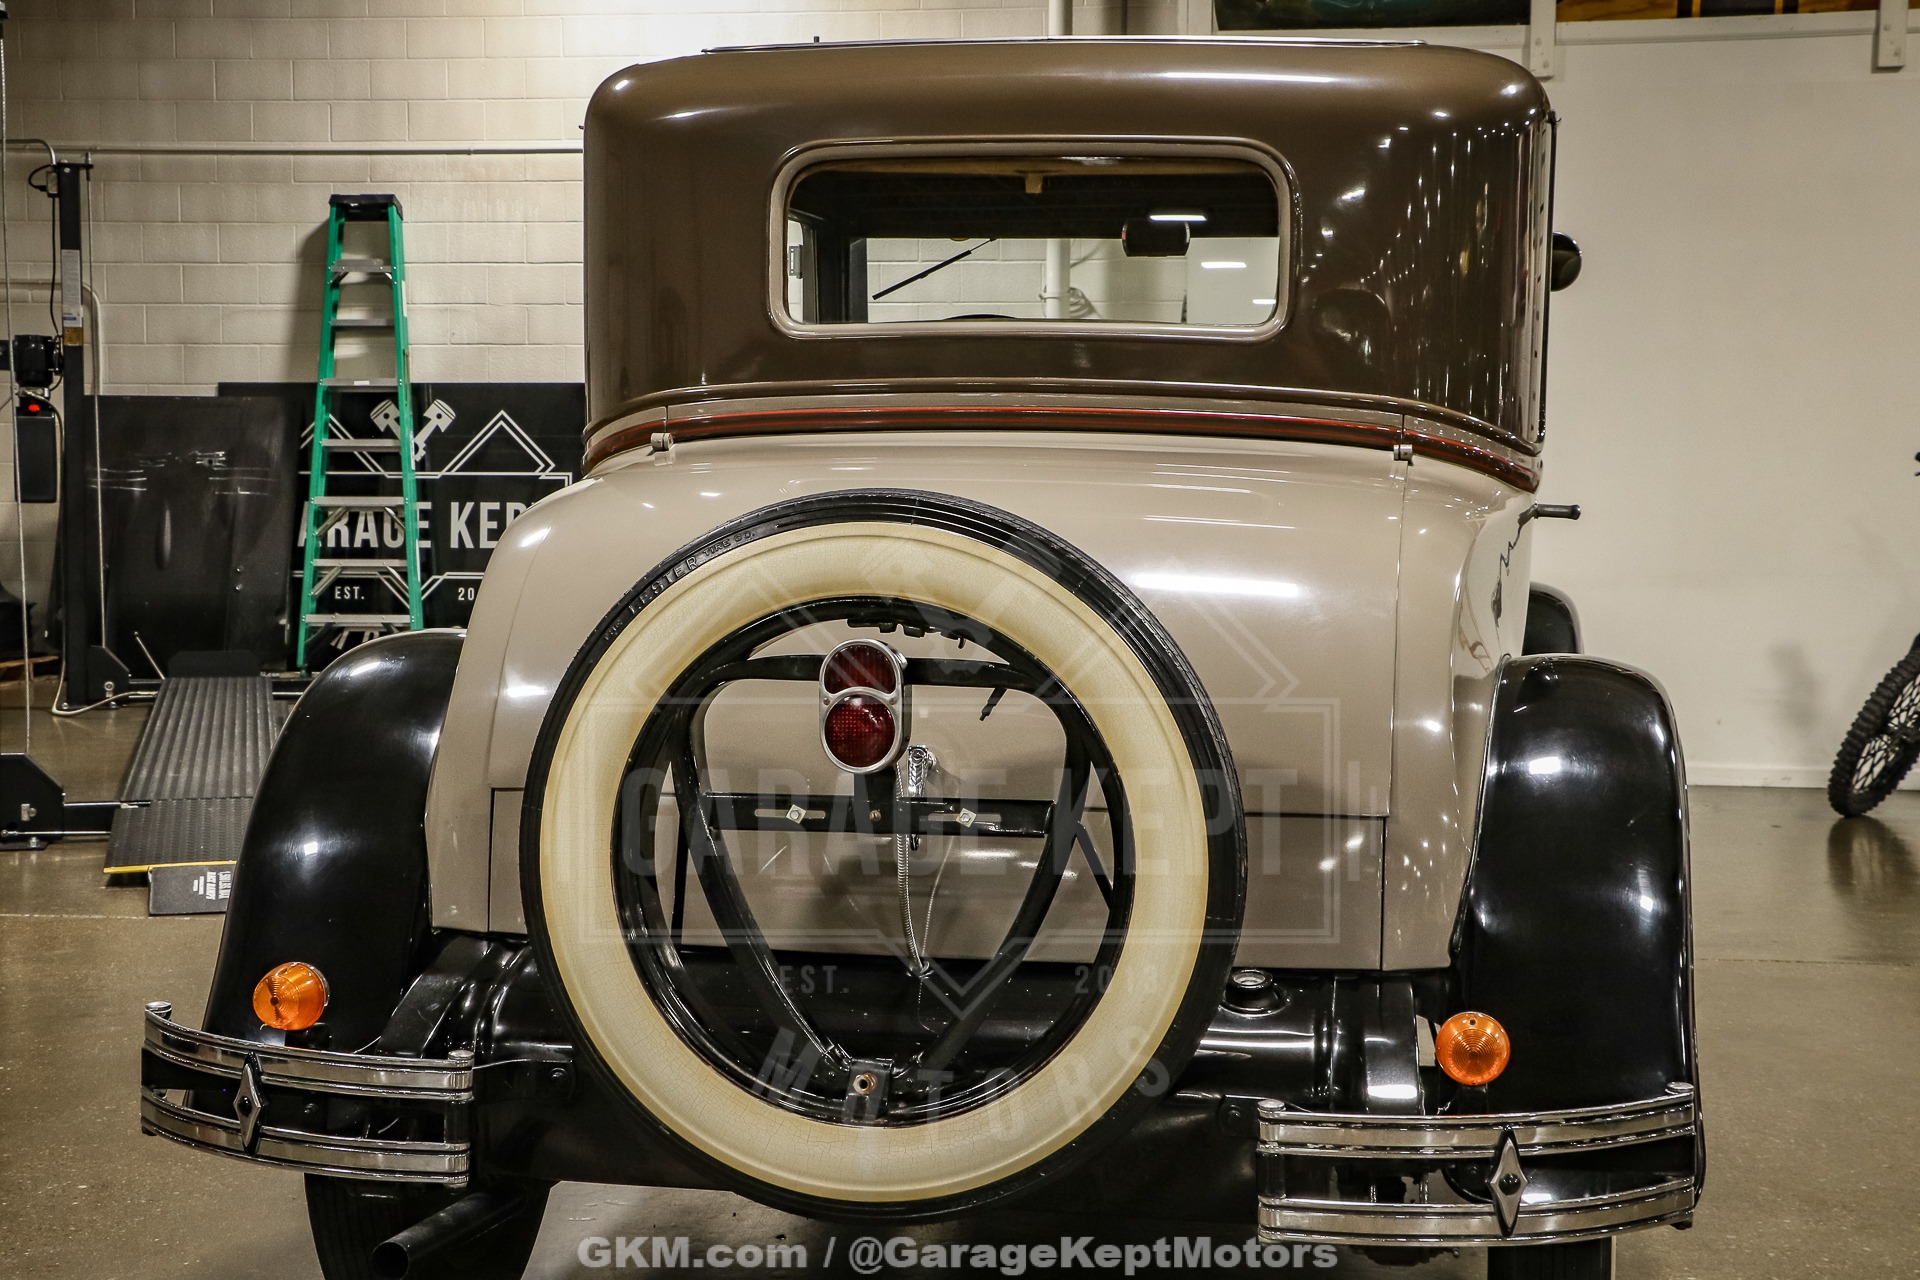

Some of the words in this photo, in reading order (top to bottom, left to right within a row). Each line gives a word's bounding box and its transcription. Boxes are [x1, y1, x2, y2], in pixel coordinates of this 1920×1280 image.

[450, 501, 532, 548] KEP
[334, 586, 365, 600] EST.
[628, 556, 698, 614] LESTER
[702, 539, 731, 556] TIRE
[734, 531, 756, 543] CO.
